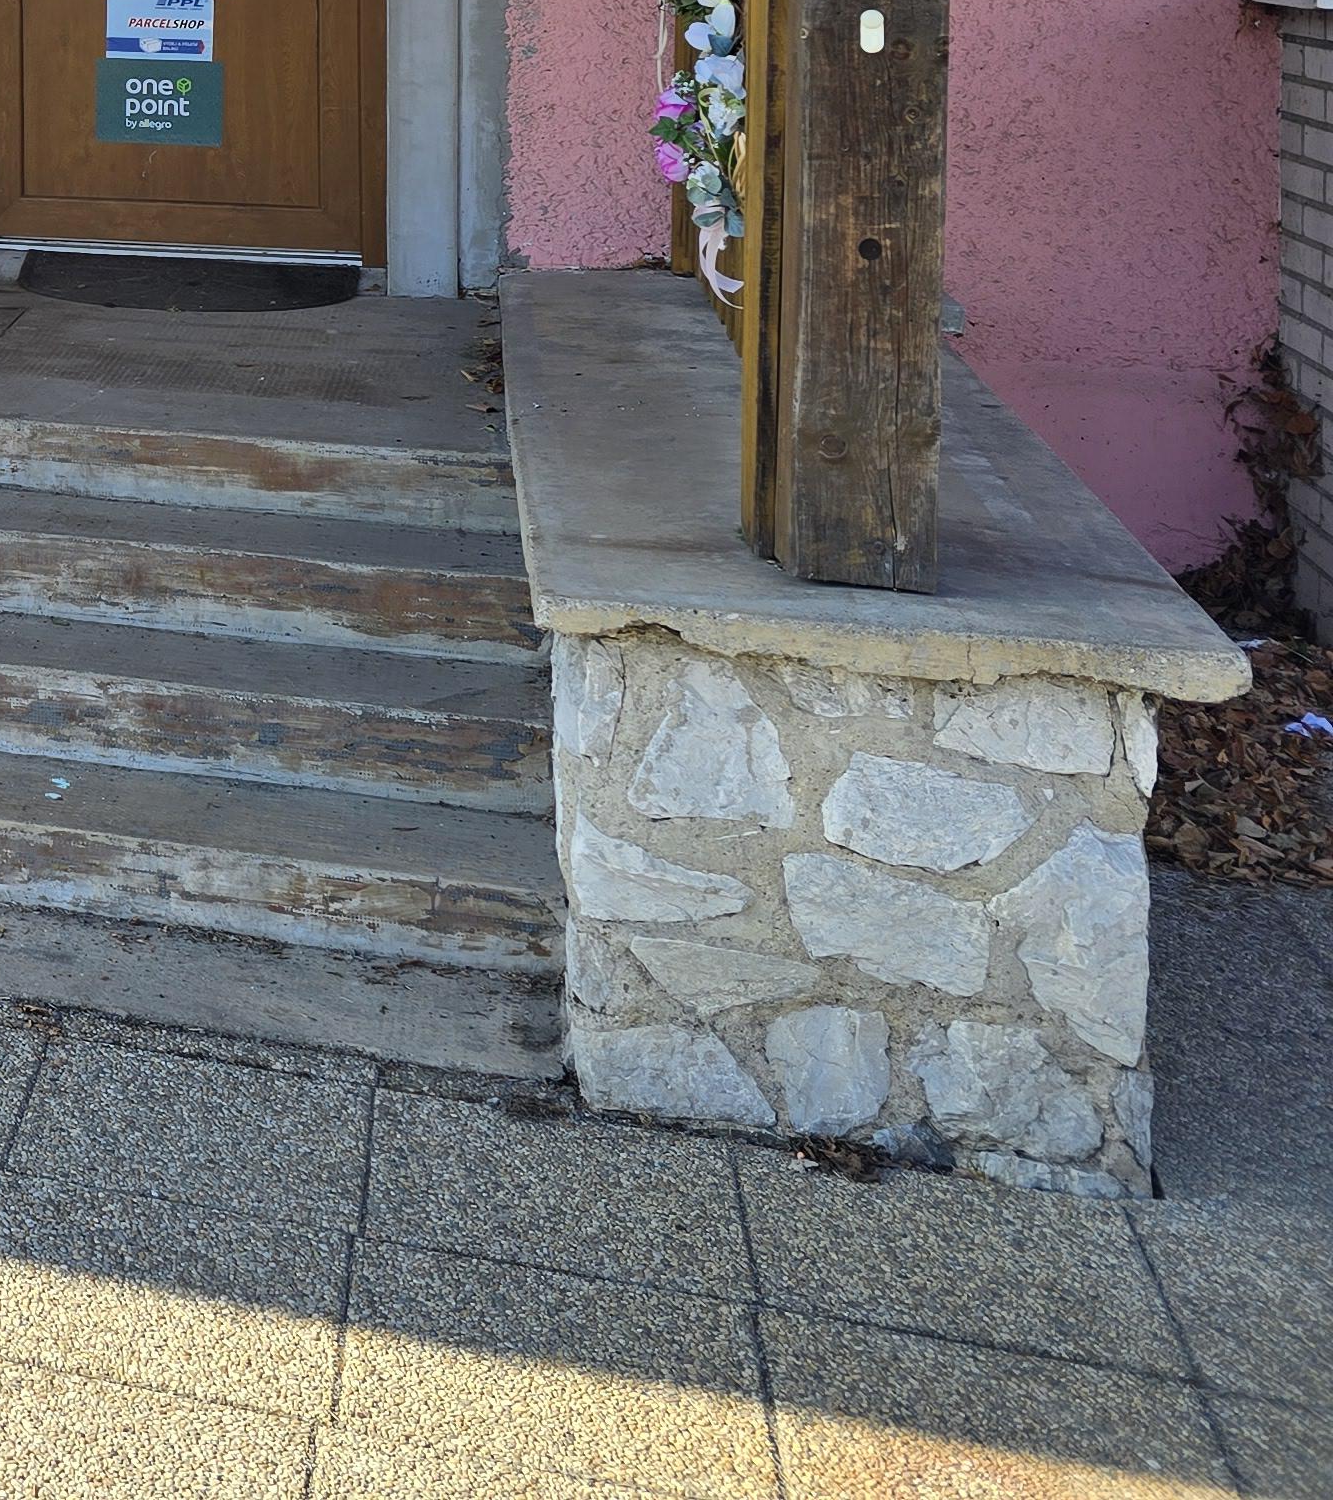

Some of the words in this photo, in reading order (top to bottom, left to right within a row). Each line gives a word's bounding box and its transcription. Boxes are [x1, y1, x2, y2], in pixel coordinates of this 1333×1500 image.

[128, 18, 205, 29] PARCELSHOP
[125, 78, 174, 95] one
[125, 97, 190, 117] point
[125, 117, 137, 129] by
[138, 118, 172, 131] allegro
